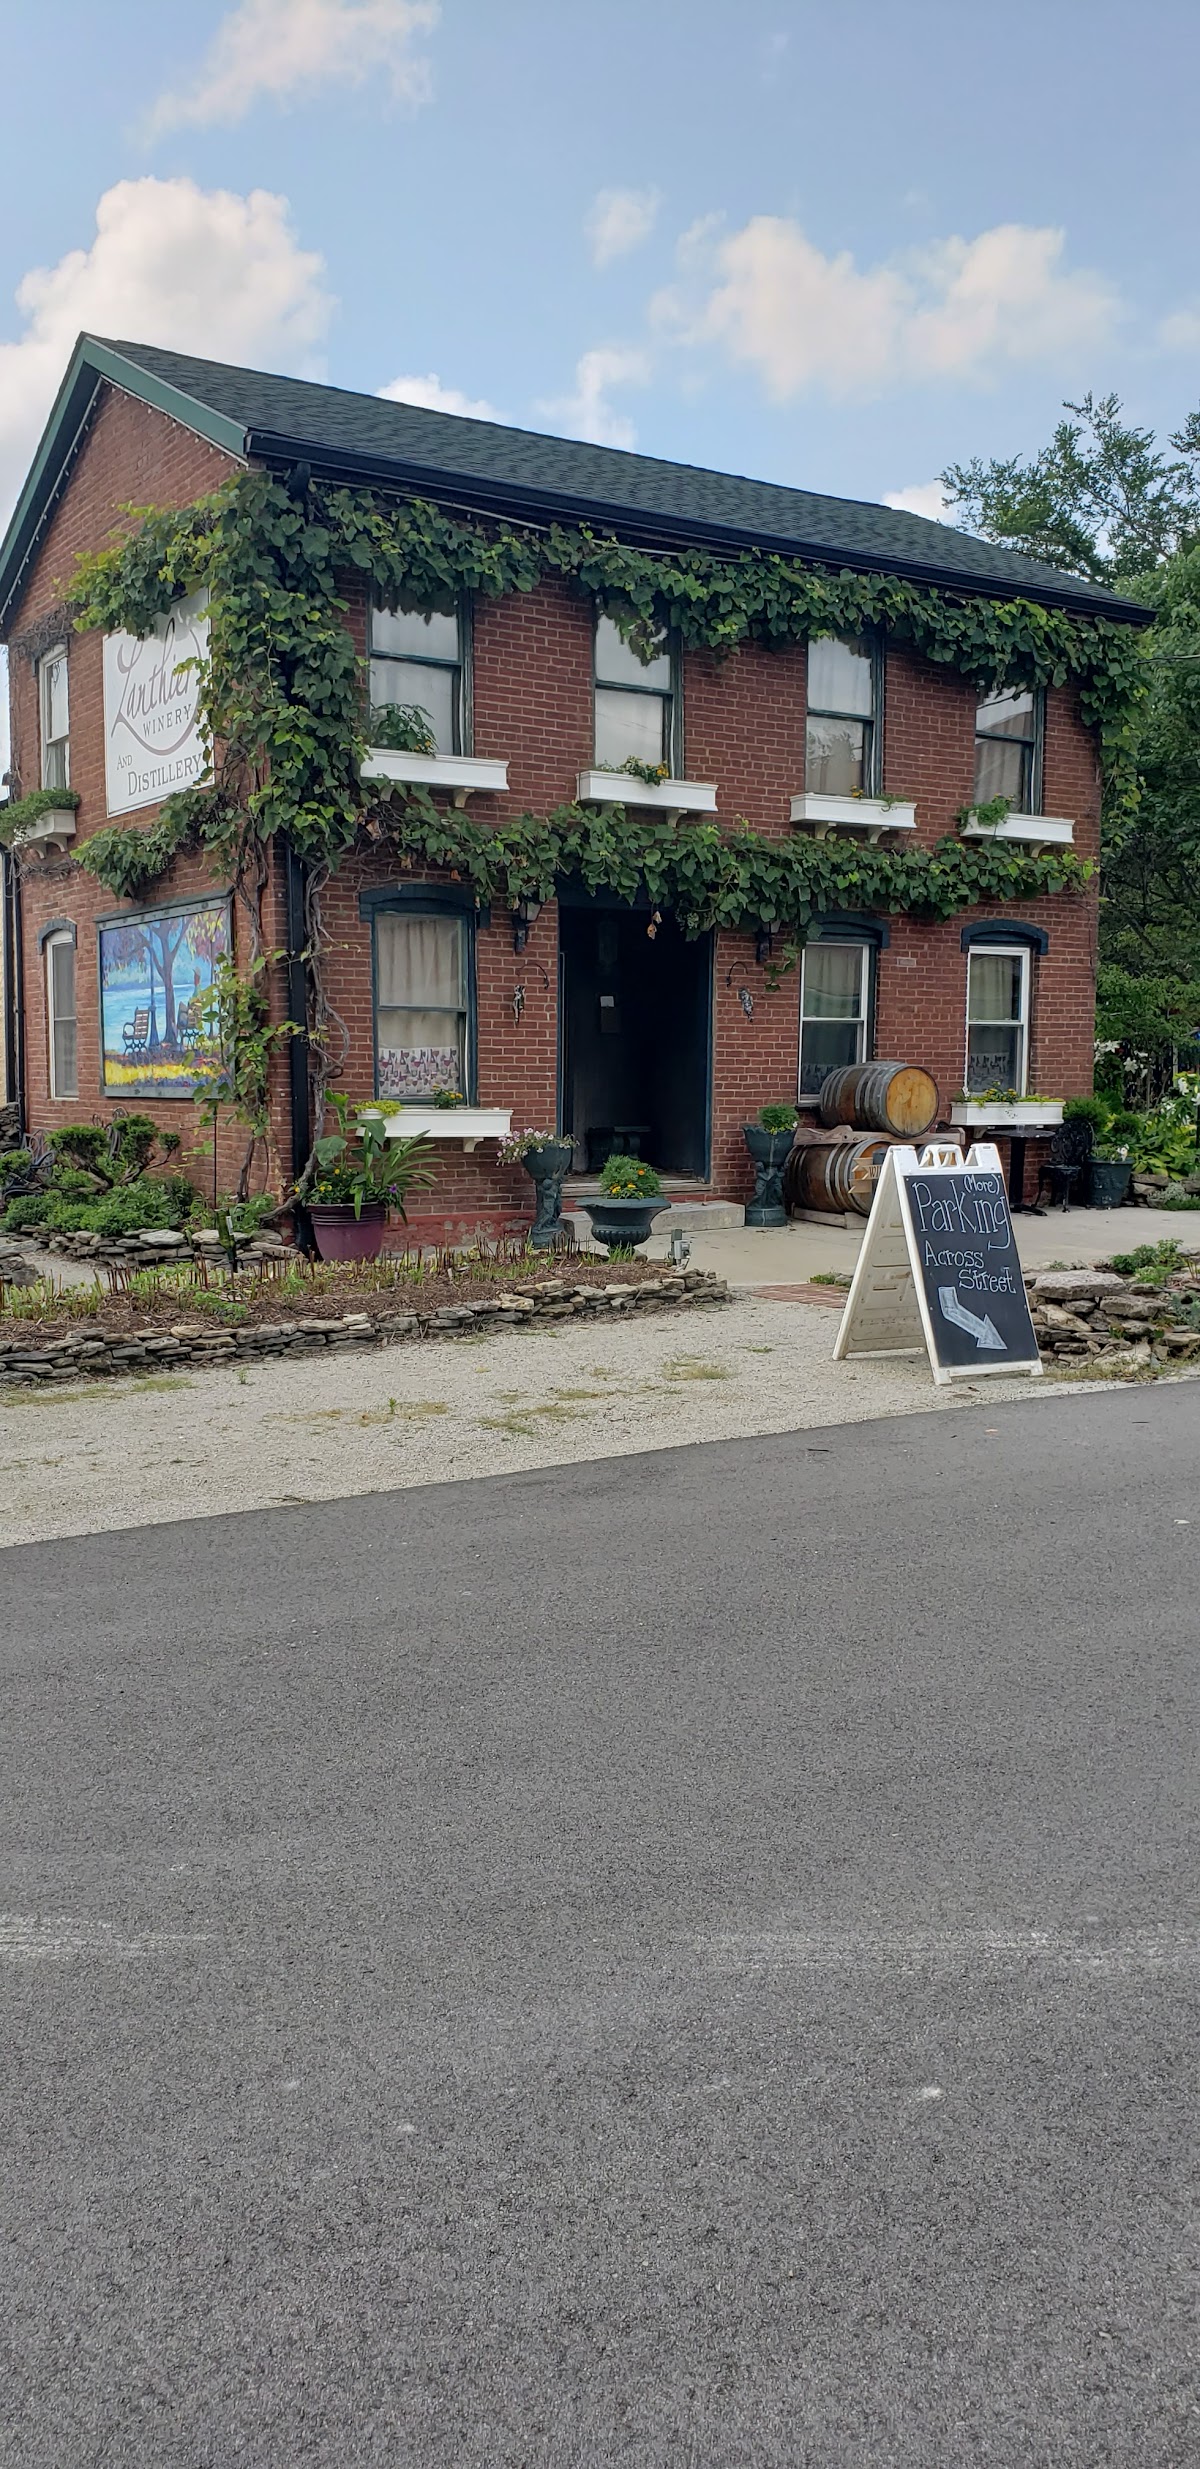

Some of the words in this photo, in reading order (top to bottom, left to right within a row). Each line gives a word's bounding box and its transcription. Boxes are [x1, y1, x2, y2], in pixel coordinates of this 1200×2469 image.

[142, 703, 193, 738] WINERY
[116, 754, 133, 771] AND
[128, 752, 203, 797] DISTILLERY
[963, 1173, 1000, 1196] (More)
[925, 1240, 985, 1269] Across
[958, 1266, 1017, 1294] Street
